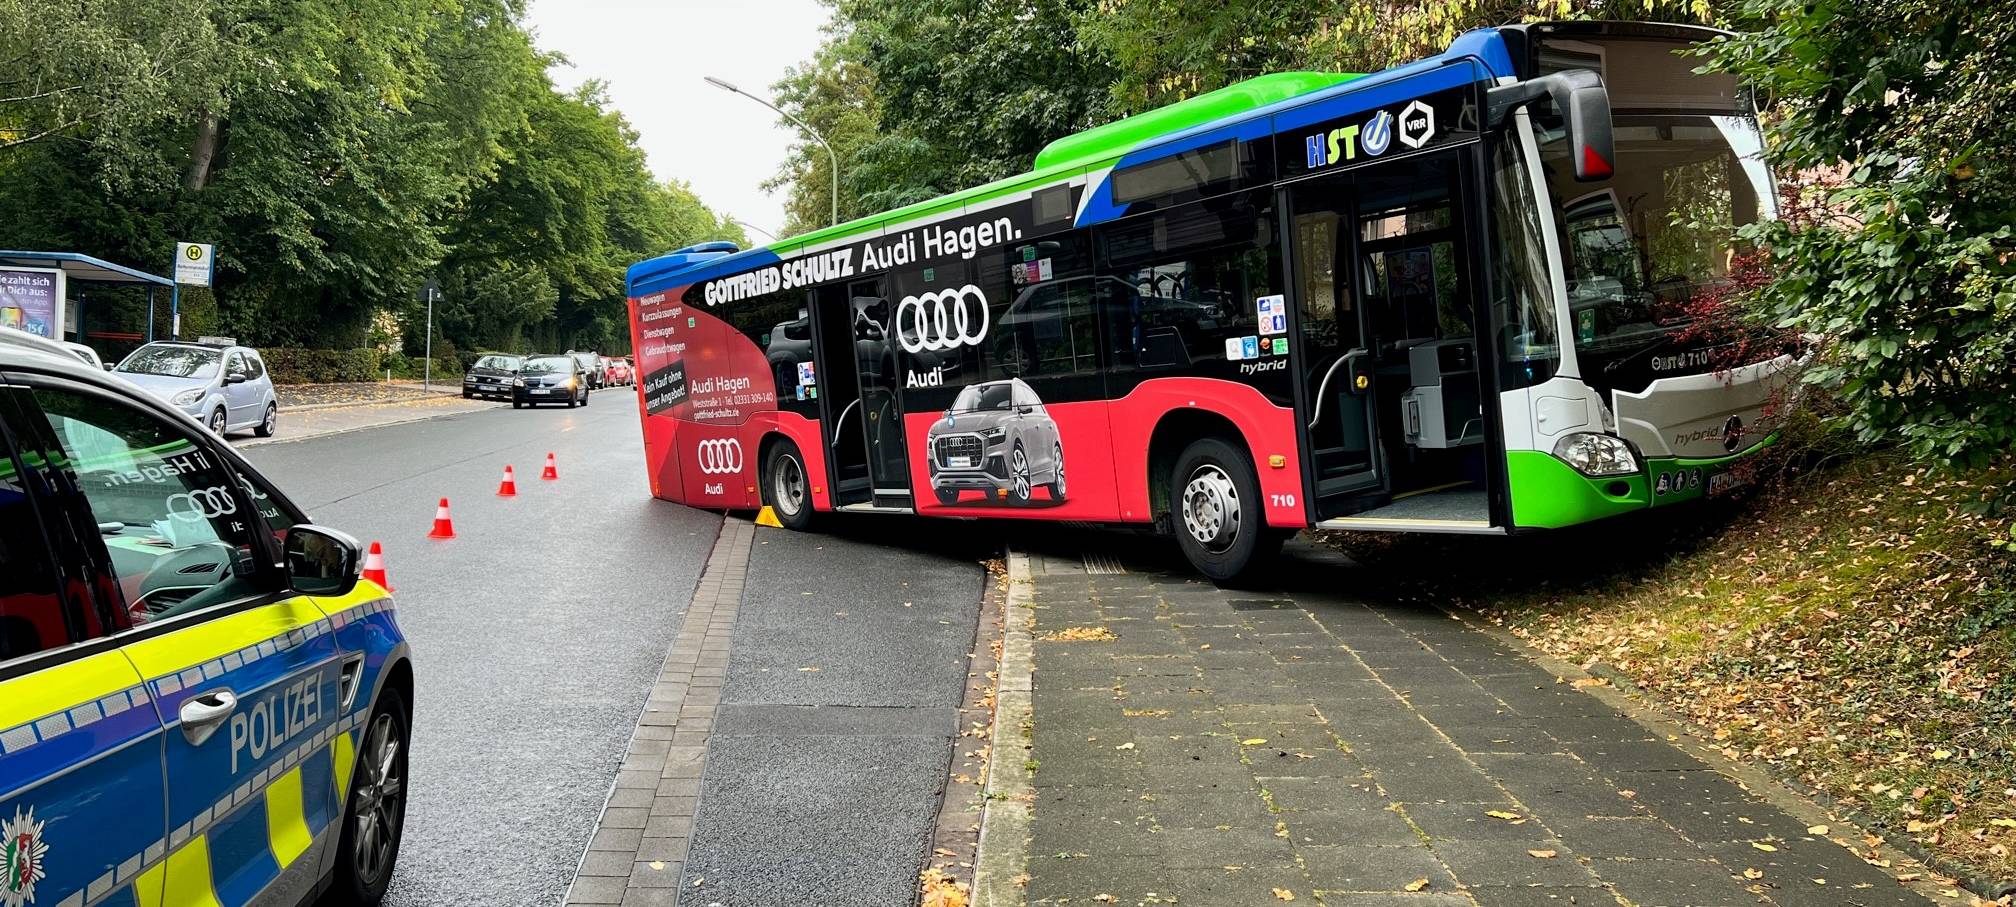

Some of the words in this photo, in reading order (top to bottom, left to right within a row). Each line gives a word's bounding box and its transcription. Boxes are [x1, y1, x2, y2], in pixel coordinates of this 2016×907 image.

[1406, 117, 1427, 132] VRR
[1306, 124, 1360, 169] HST
[704, 266, 780, 307] GOTTFRIED
[782, 247, 854, 290] SCHULTZ
[860, 225, 915, 273] Audi
[923, 216, 1022, 260] Hagen.
[8, 276, 31, 286] zahlt
[32, 277, 50, 287] sich
[8, 285, 27, 295] Dich
[29, 288, 48, 297] aus:
[644, 326, 675, 340] Dienstwagen
[1688, 351, 1708, 366] 710
[1240, 359, 1287, 375] hybrid
[643, 381, 656, 394] Kein
[655, 373, 668, 389] Kauf
[668, 371, 683, 384] ohne
[691, 377, 714, 394] Audi
[716, 376, 750, 394] Hagen
[906, 366, 943, 390] Audi
[646, 397, 661, 410] unser
[661, 384, 686, 404] Angebot!
[734, 394, 751, 405] 02331
[751, 392, 774, 404] 309-140
[1674, 426, 1719, 447] hybrid
[705, 482, 724, 495] Audi
[1270, 494, 1295, 507] 710
[230, 670, 324, 775] POLIZEI
